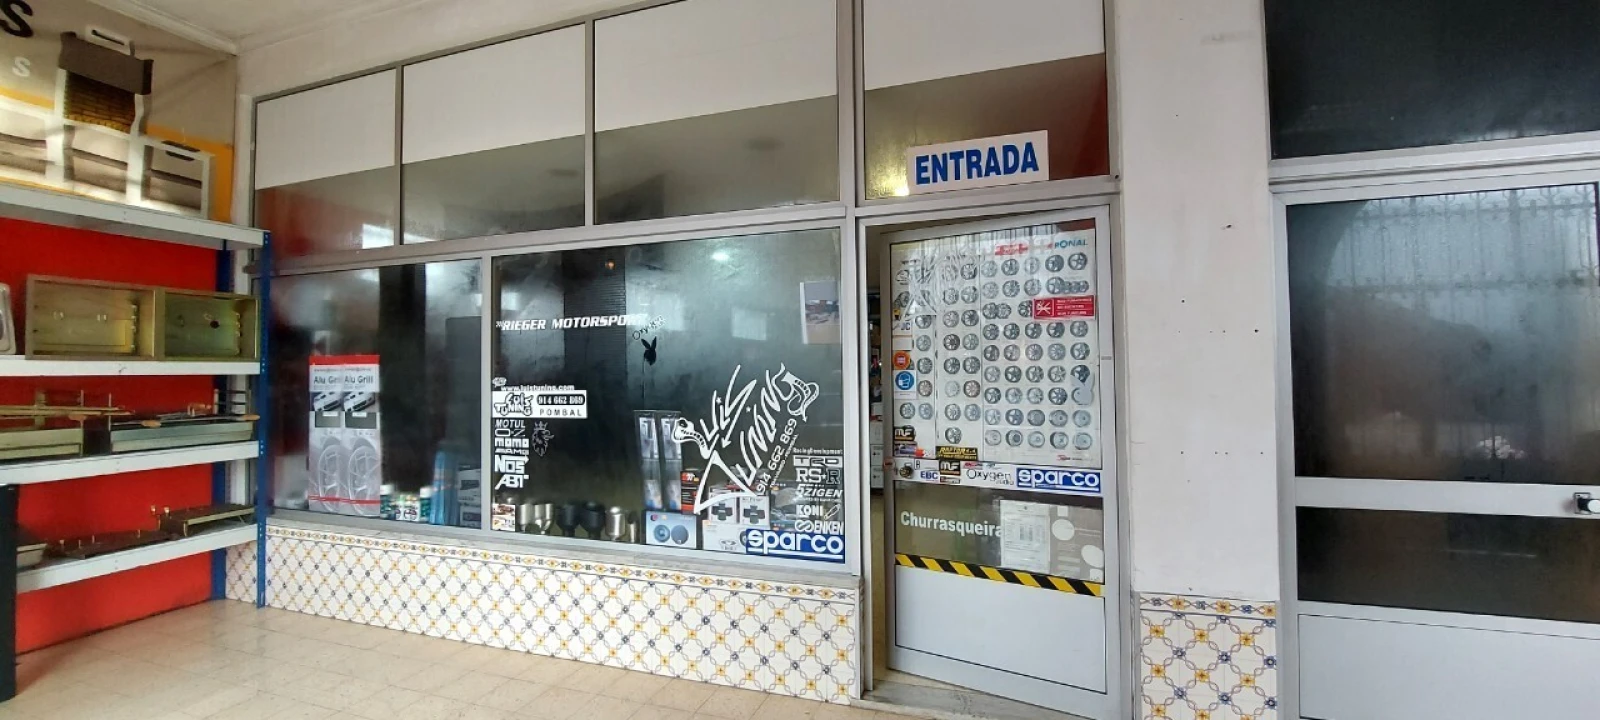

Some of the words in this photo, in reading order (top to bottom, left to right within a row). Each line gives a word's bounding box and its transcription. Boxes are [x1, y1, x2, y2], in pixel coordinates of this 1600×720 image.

[916, 142, 1039, 185] ENTRADA
[1055, 239, 1088, 249] RONAL
[502, 319, 546, 331] RIEGER
[358, 375, 373, 384] Grill
[538, 396, 552, 405] 914
[553, 396, 567, 405] 662
[539, 408, 582, 416] POMBAL
[495, 419, 526, 428] MOTUL
[495, 454, 529, 474] NOS
[755, 472, 772, 496] 914
[768, 445, 786, 471] 662
[780, 418, 798, 444] 869
[494, 474, 530, 490] ABT
[920, 470, 939, 480] EBC
[966, 468, 1012, 482] Oxygen
[1018, 469, 1100, 488] sparco
[795, 484, 843, 498] 5ZIGEN
[796, 505, 824, 517] KONI
[900, 511, 1002, 537] Churrasqueira
[748, 529, 844, 554] sparco
